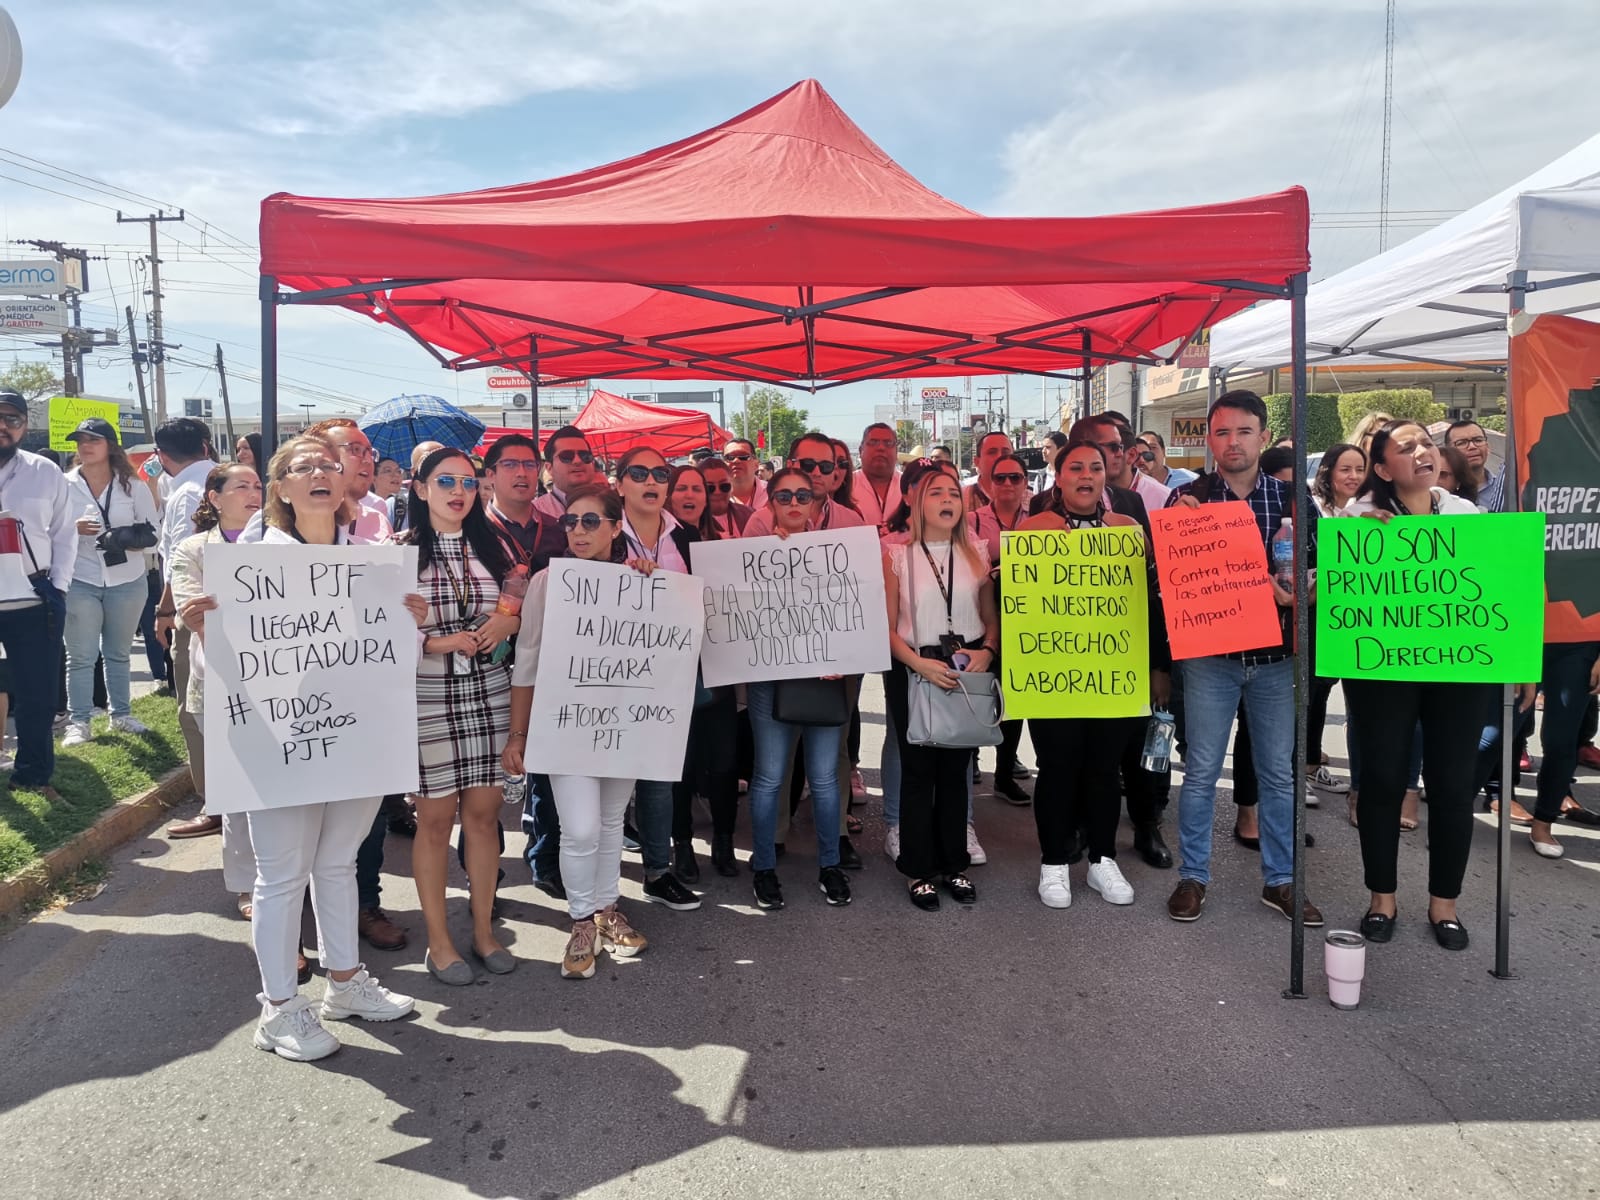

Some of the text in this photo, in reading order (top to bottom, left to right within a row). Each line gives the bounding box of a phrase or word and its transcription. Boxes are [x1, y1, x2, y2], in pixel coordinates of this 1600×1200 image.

[5, 304, 56, 312] ORIENTACIÓN
[6, 312, 35, 320] MÉDICA
[922, 390, 947, 398] OXXO
[1536, 486, 1600, 514] RESPE
[1156, 518, 1174, 533] Te
[1544, 523, 1600, 551] ERECH
[1001, 530, 1145, 558] TODOS UNIDOS
[1168, 539, 1228, 561] Amparo
[1336, 527, 1385, 565] NO
[1394, 526, 1456, 564] SON
[742, 542, 849, 582] RESPETO
[1011, 563, 1134, 586] EN DEFENSA
[1169, 559, 1262, 587] Contra todas
[309, 562, 367, 598] PJF
[562, 568, 667, 612] SIN PJF
[722, 583, 743, 616] LA
[751, 571, 860, 610] DIVISION
[1175, 587, 1198, 600] las
[1326, 566, 1483, 602] PRIVILEGIOS
[364, 607, 387, 624] LA
[1003, 593, 1128, 617] DE NUESTROS
[1174, 599, 1243, 630] ¡Amparo!
[1328, 602, 1509, 632] SON NUESTROS
[576, 615, 693, 651] LA DICTADURA
[705, 600, 865, 644] E INDEPENDENCIA
[748, 631, 837, 667] JUDICIAL
[1019, 629, 1131, 656] DERECHOS
[239, 638, 397, 682] DICTADURA
[1009, 668, 1137, 696] LABORALES
[224, 692, 332, 726] # TODOS
[553, 703, 677, 729] #TODOS SOMOS
[290, 712, 357, 737] SOMOS
[282, 736, 339, 765] PJF
[593, 728, 629, 752] PJF
